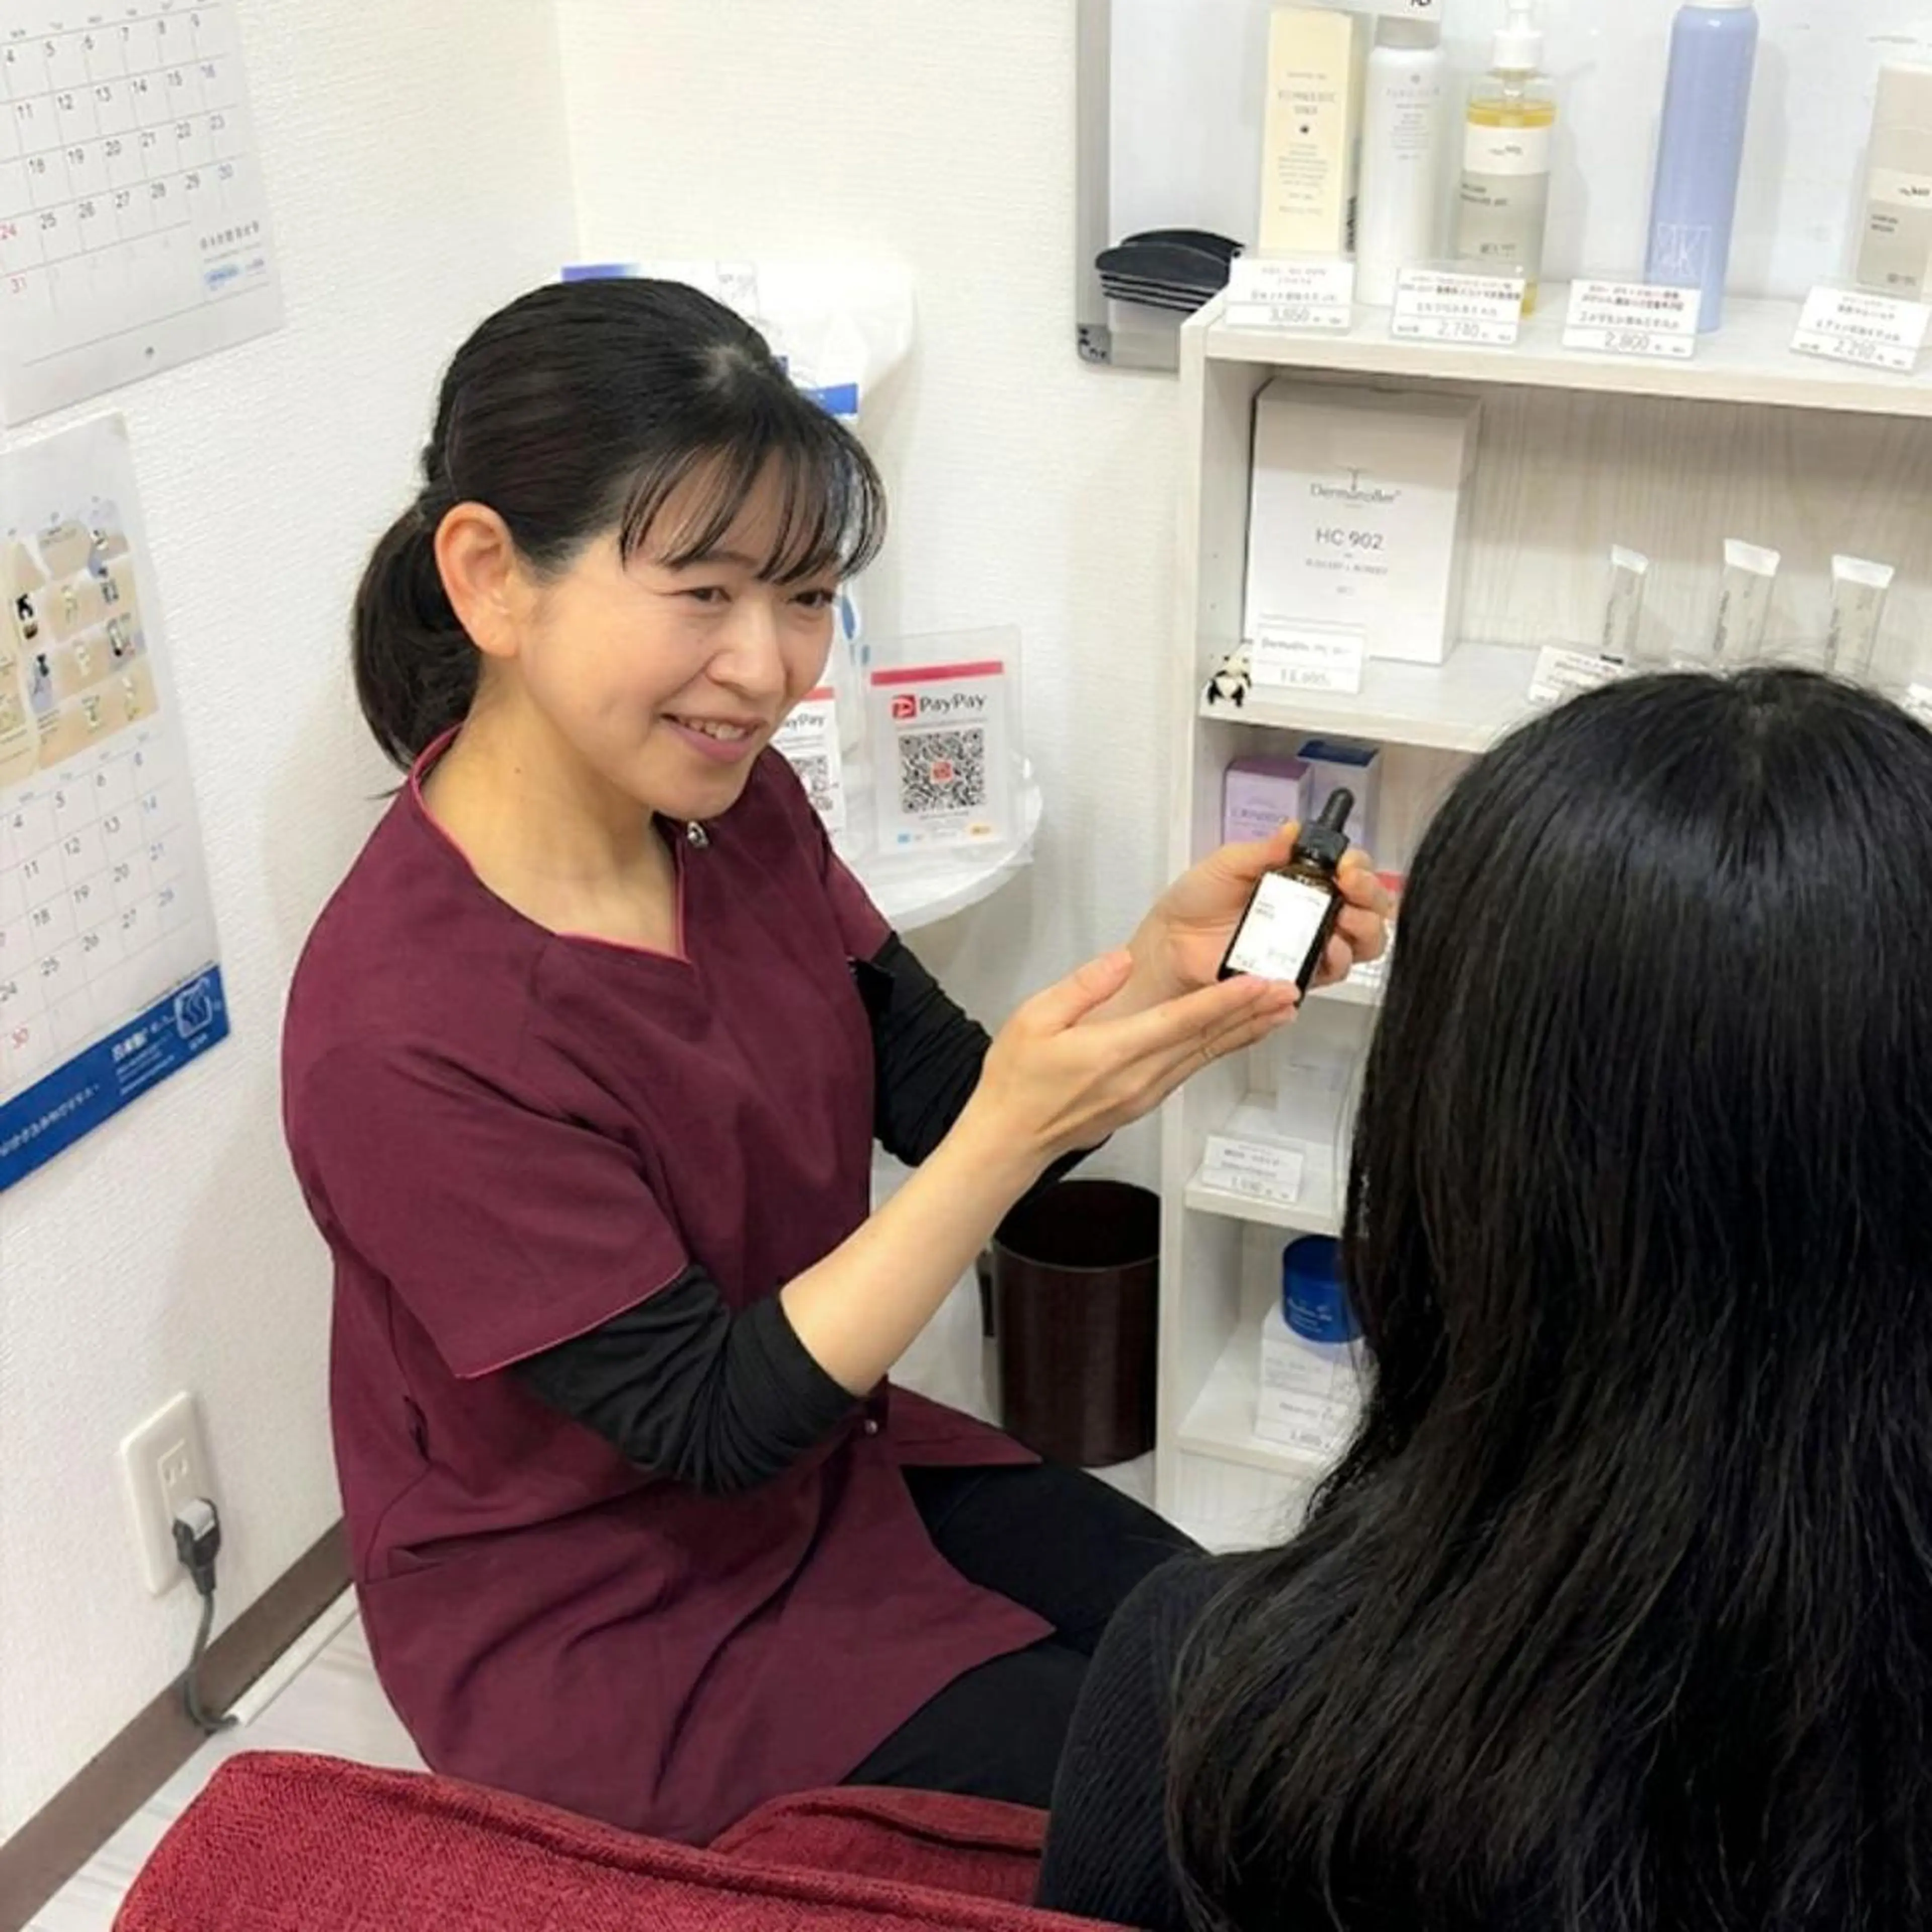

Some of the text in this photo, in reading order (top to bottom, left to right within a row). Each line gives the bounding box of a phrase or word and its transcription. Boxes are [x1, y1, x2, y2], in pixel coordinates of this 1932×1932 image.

[7, 49, 15, 62] 4
[45, 40, 55, 57] 5
[83, 34, 96, 50] 6
[121, 26, 129, 42] 7
[18, 104, 33, 120] 11
[57, 94, 72, 110] 12
[96, 86, 112, 102] 13
[132, 79, 147, 94] 14
[168, 70, 182, 86] 15
[29, 158, 45, 174] 18
[68, 148, 84, 165] 19
[106, 140, 122, 157] 20
[141, 131, 156, 147] 21
[177, 122, 191, 139] 22
[0, 224, 17, 240] 24
[40, 212, 56, 230] 25
[79, 201, 96, 218] 26
[117, 190, 130, 208] 27
[11, 277, 27, 293] 31
[1316, 527, 1385, 551] HC 902
[920, 693, 987, 714] PayPay
[14, 814, 24, 828] 4
[55, 790, 65, 809] 5
[25, 859, 39, 879] 11
[65, 836, 80, 855] 12
[104, 816, 120, 833] 13
[33, 909, 51, 927] 18
[74, 884, 91, 903] 19
[114, 862, 131, 882] 20
[41, 957, 60, 977] 25
